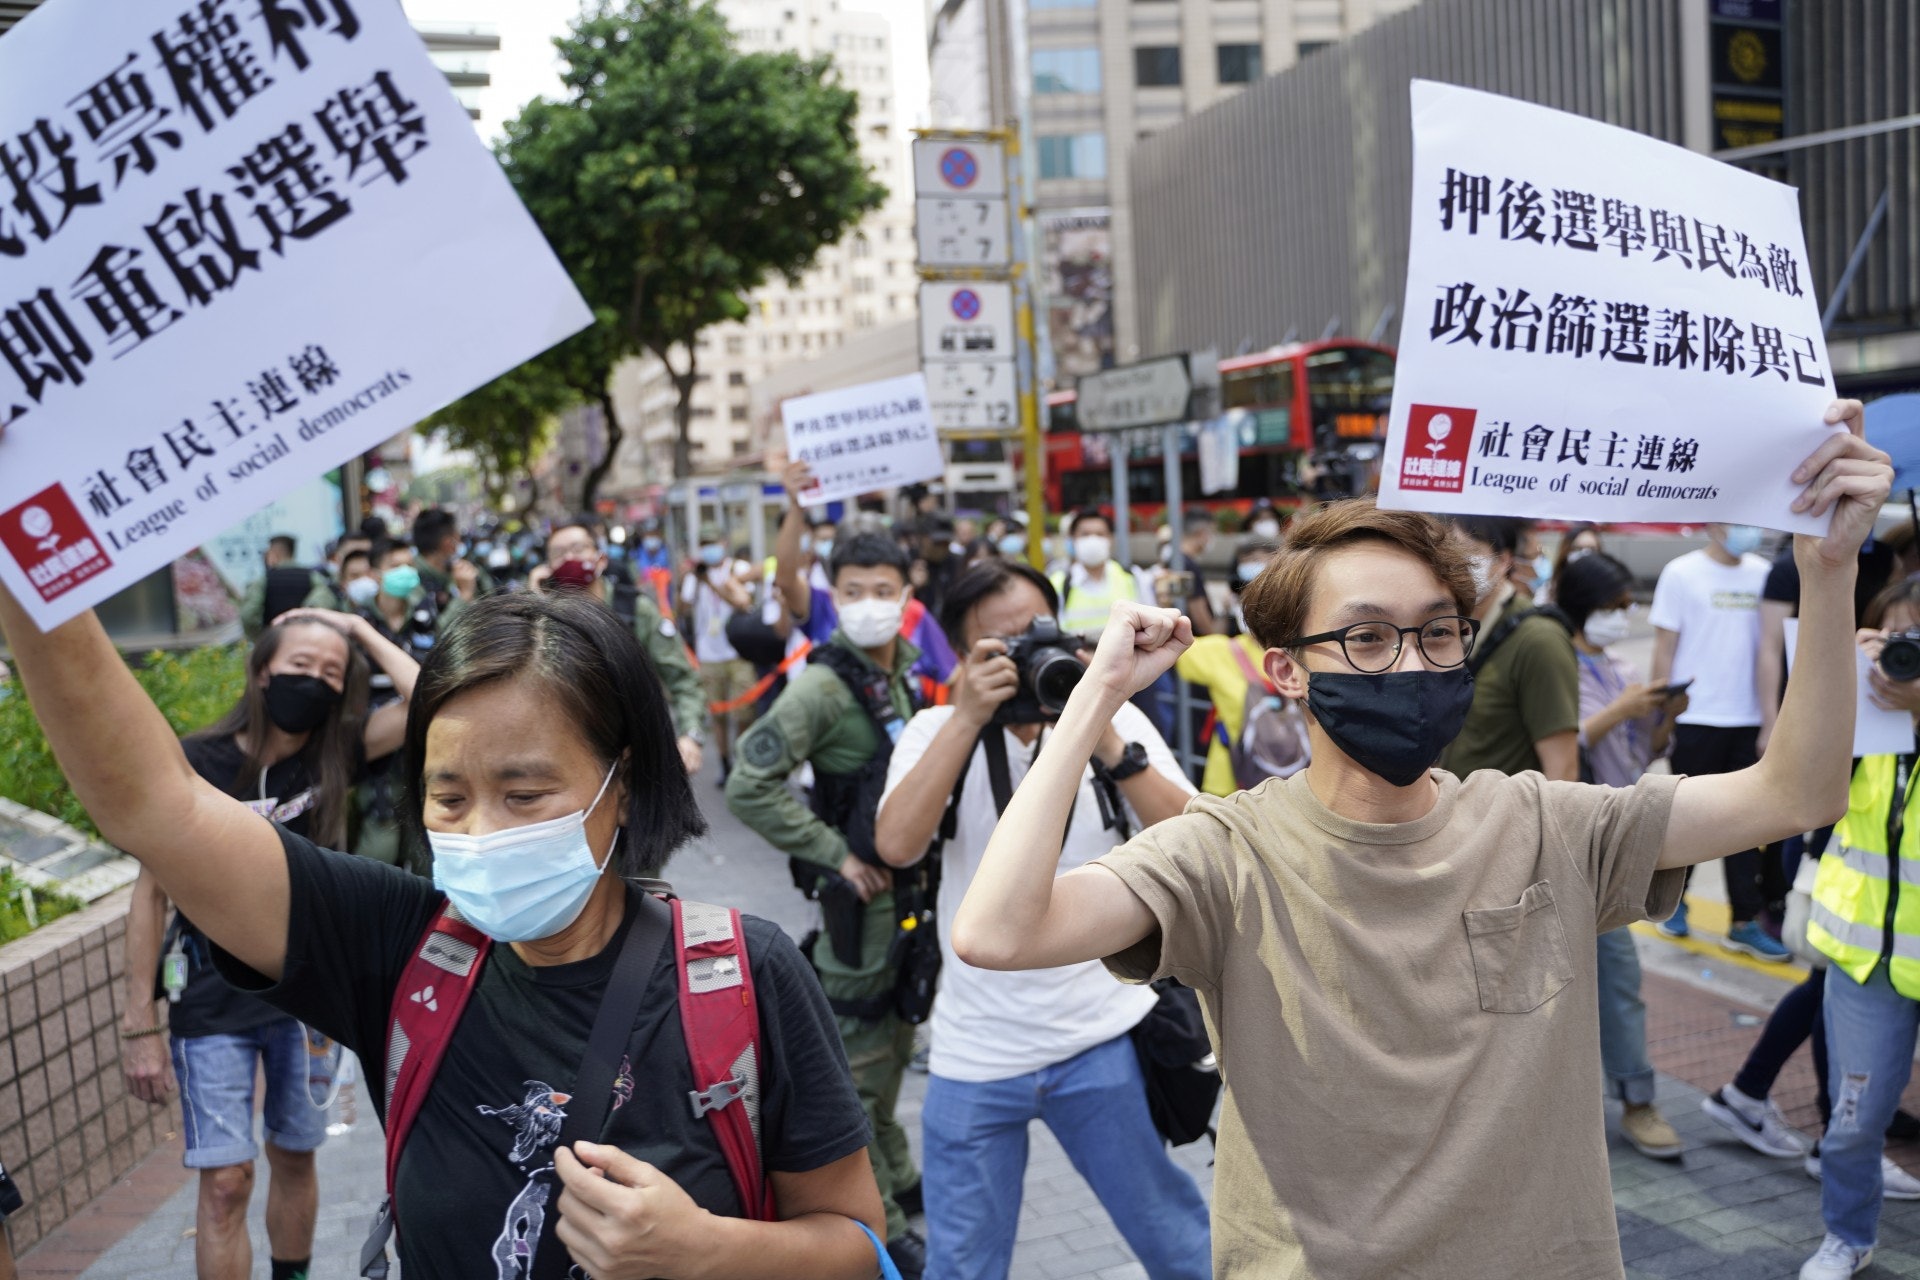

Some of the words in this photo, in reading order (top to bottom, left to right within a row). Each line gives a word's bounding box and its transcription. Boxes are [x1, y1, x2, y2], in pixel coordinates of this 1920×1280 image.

[0, 0, 361, 257] 投票權利
[0, 71, 430, 427] 即重啟選舉
[1438, 167, 1804, 300] 押後選舉與民為敵
[1430, 281, 1826, 388] 政治篩選誅除異己
[81, 344, 341, 518] 社會民主連線
[106, 498, 188, 551] League
[195, 472, 220, 503] of
[227, 433, 292, 484] social
[297, 366, 413, 443] democrats
[1470, 466, 1538, 494] League
[1550, 473, 1571, 493] of
[1578, 476, 1630, 497] social
[1636, 479, 1720, 500] democrats
[1477, 421, 1700, 474] 社會民主連線
